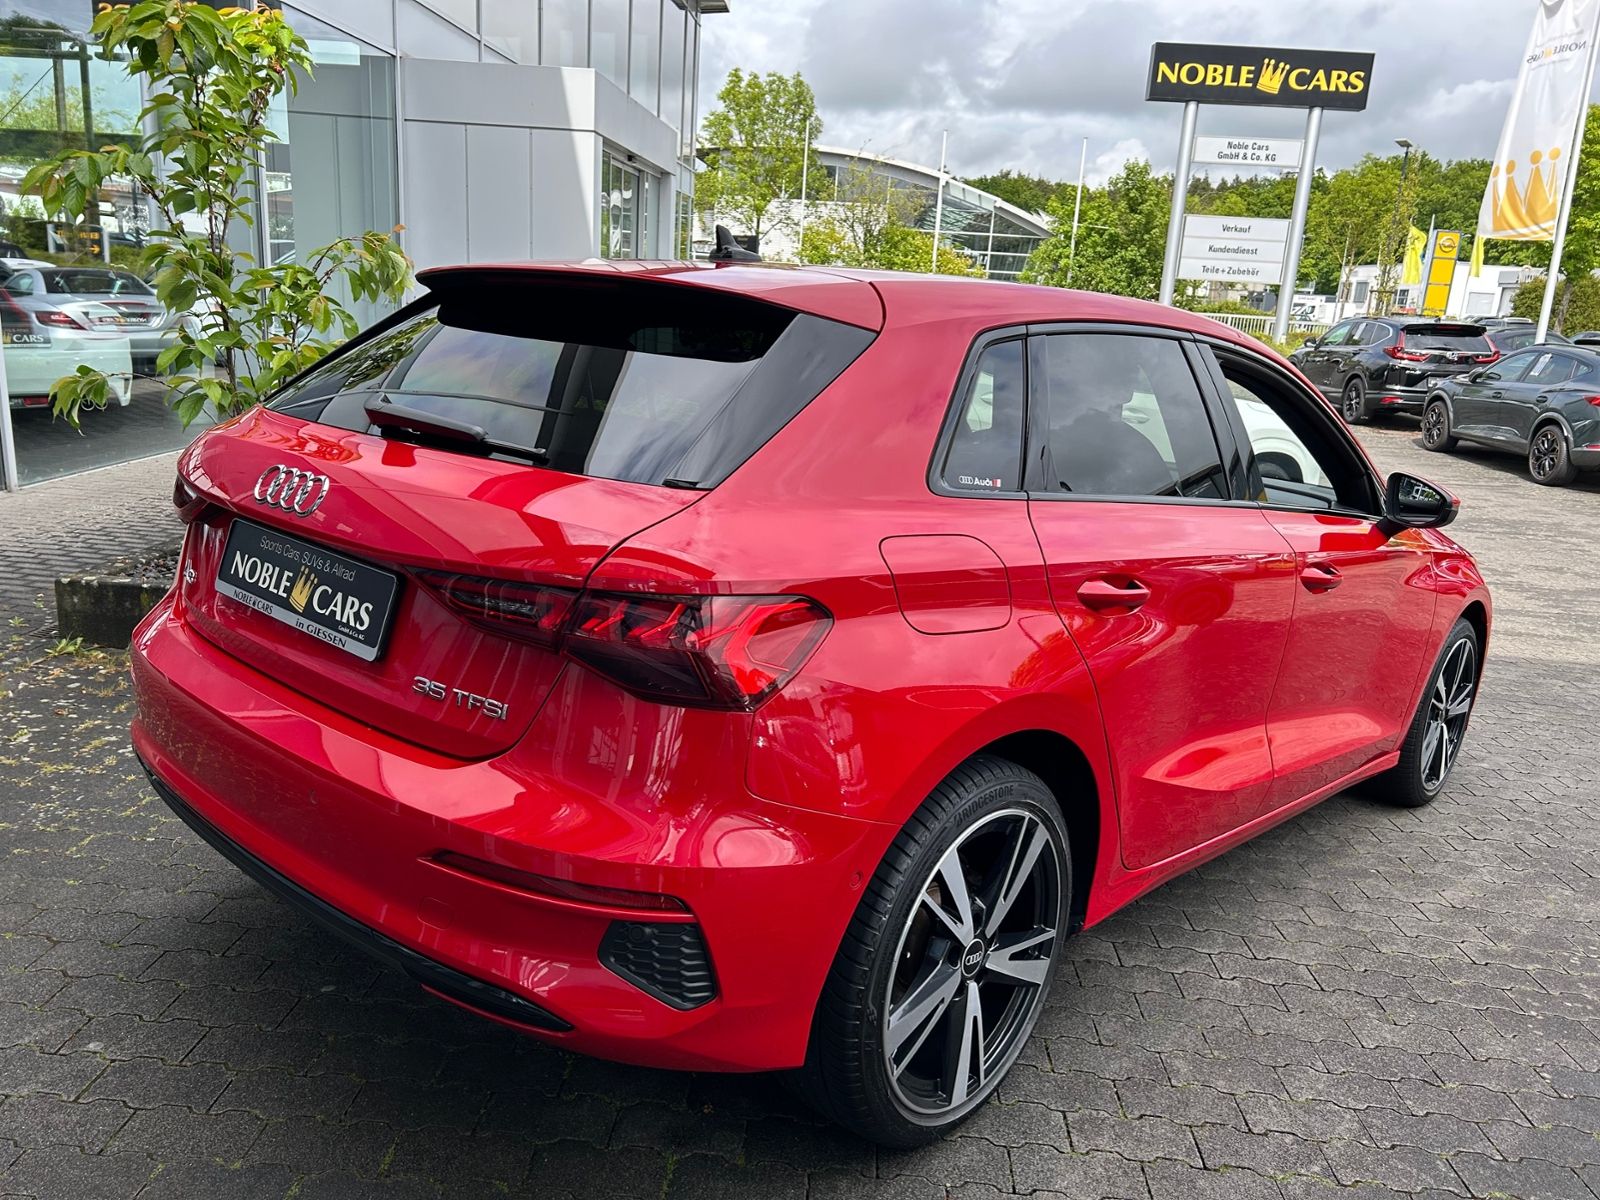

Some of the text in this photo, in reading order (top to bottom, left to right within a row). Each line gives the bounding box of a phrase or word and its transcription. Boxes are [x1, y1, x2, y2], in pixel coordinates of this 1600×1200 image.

[1156, 61, 1366, 94] NOBLE CARS
[1217, 151, 1277, 162] GmbH & Co. KG
[1227, 141, 1270, 151] Noble Cars
[1221, 224, 1251, 233] Verkauf
[1208, 244, 1258, 255] Kundendienst
[12, 333, 45, 344] CARS
[259, 535, 282, 554] Sports
[301, 551, 323, 570] SUVs
[323, 559, 331, 573] &
[330, 562, 357, 581] Allrad
[230, 550, 294, 598] NOBLE
[312, 584, 374, 631] CARS
[233, 589, 274, 615] NOBLE CARS
[295, 617, 347, 649] in GIESSEN
[412, 675, 509, 720] 35 TFSI
[953, 784, 1014, 827] BRIDGESTONE
